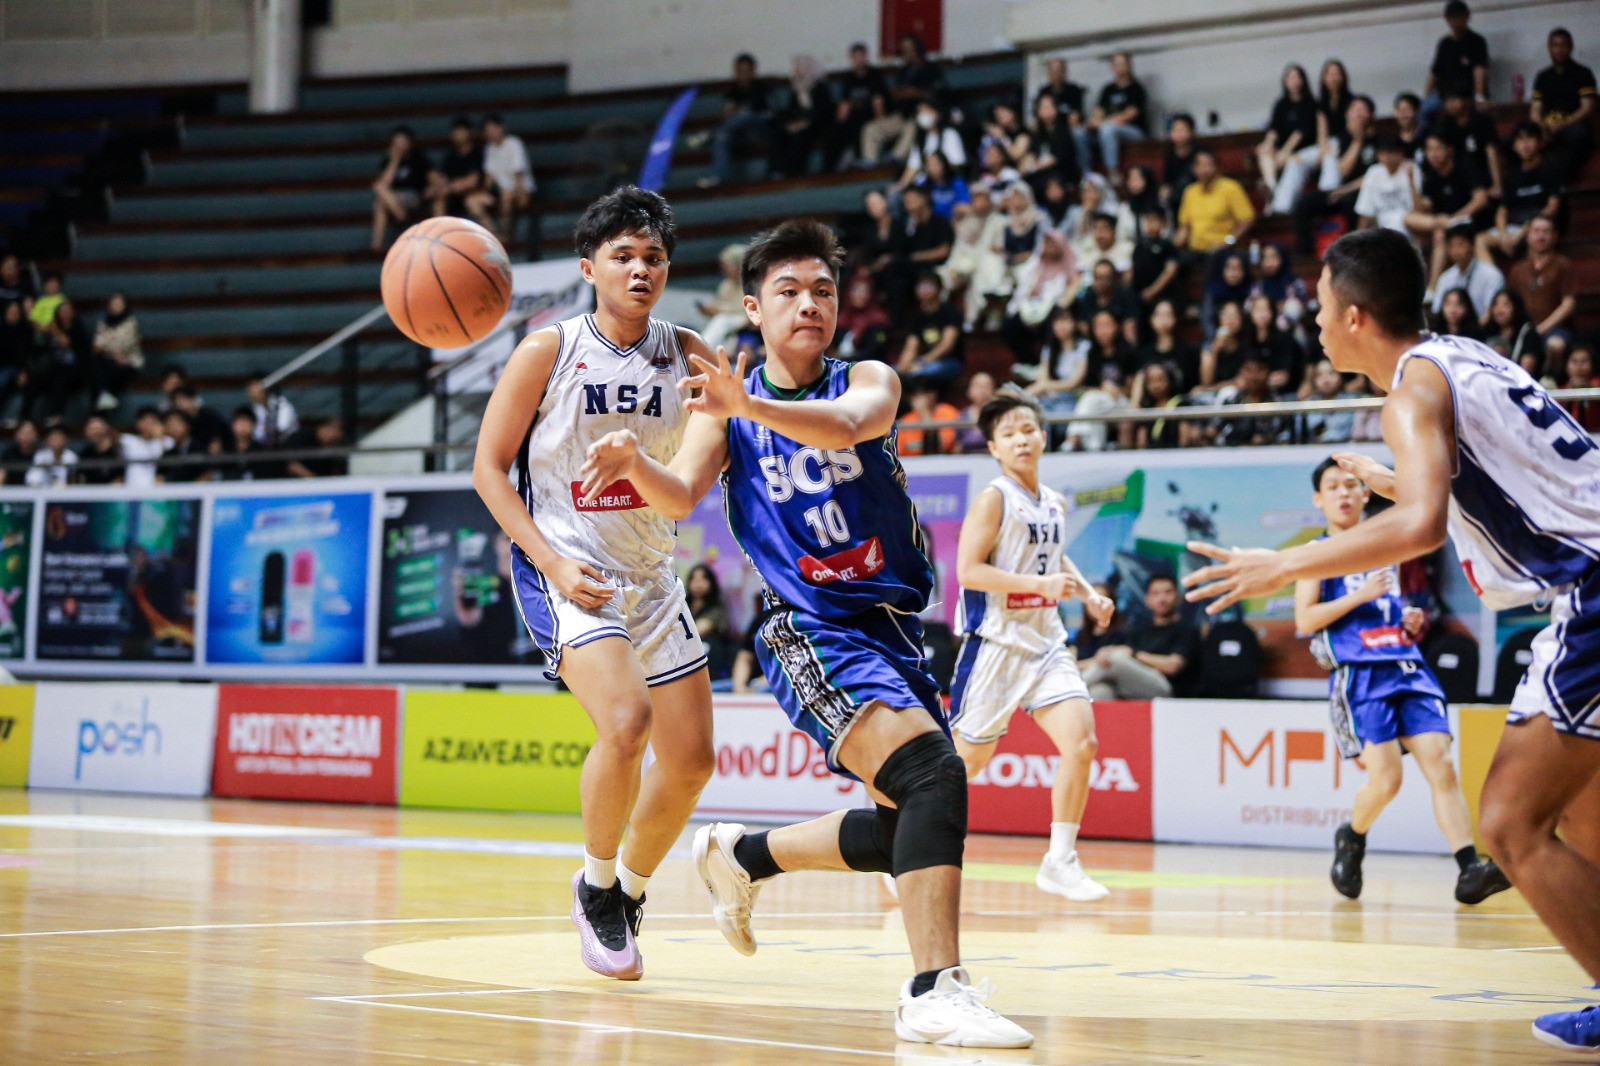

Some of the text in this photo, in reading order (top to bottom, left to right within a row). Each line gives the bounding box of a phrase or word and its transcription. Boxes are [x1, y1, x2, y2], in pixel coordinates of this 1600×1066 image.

[584, 384, 662, 417] NSA
[758, 446, 864, 503] SCS
[599, 495, 632, 507] HEART.
[803, 500, 851, 548] 10
[1028, 523, 1060, 544] NSA
[1038, 554, 1047, 575] 3
[1376, 598, 1391, 623] 7
[678, 613, 693, 640] 1
[75, 696, 163, 782] posh
[716, 730, 856, 794] oodDa
